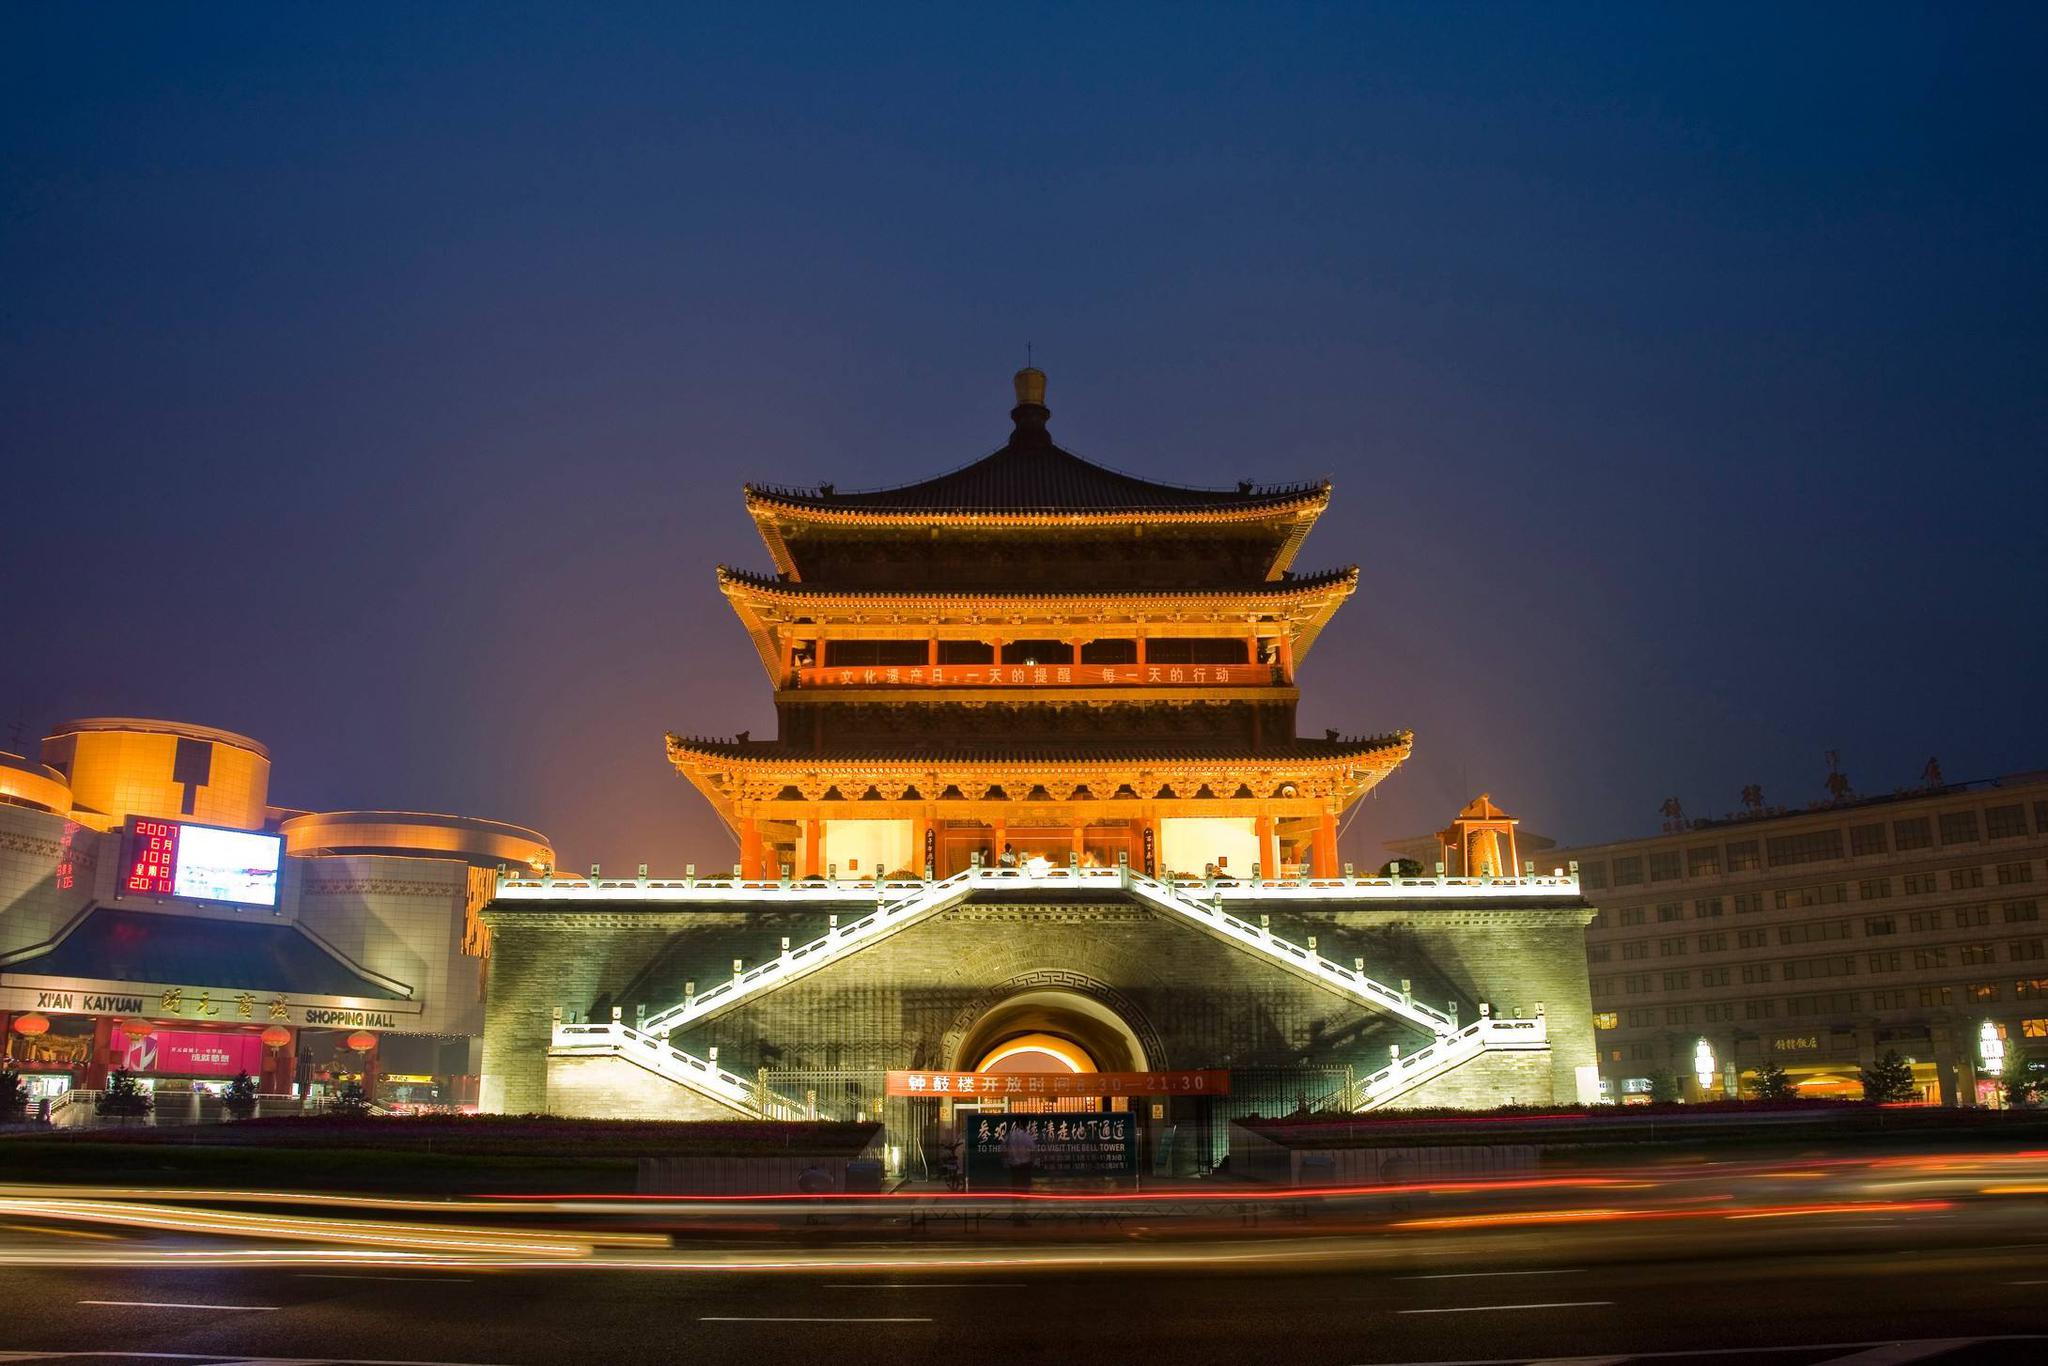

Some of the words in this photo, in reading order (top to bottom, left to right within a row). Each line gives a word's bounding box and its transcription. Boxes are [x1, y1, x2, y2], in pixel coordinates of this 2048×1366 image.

[1102, 667, 1229, 683] 每一天的行动
[136, 822, 178, 837] 2007
[151, 838, 172, 850] 6月
[143, 850, 170, 864] 10日
[129, 876, 171, 892] 20:10
[37, 993, 73, 1009] XI'AN
[83, 995, 142, 1013] KAIYUAN
[305, 1009, 363, 1027] SHOPPING
[365, 1013, 395, 1028] MALL
[1067, 1144, 1080, 1152] THE
[1082, 1144, 1098, 1152] BELL
[1100, 1143, 1125, 1152] TOWER
